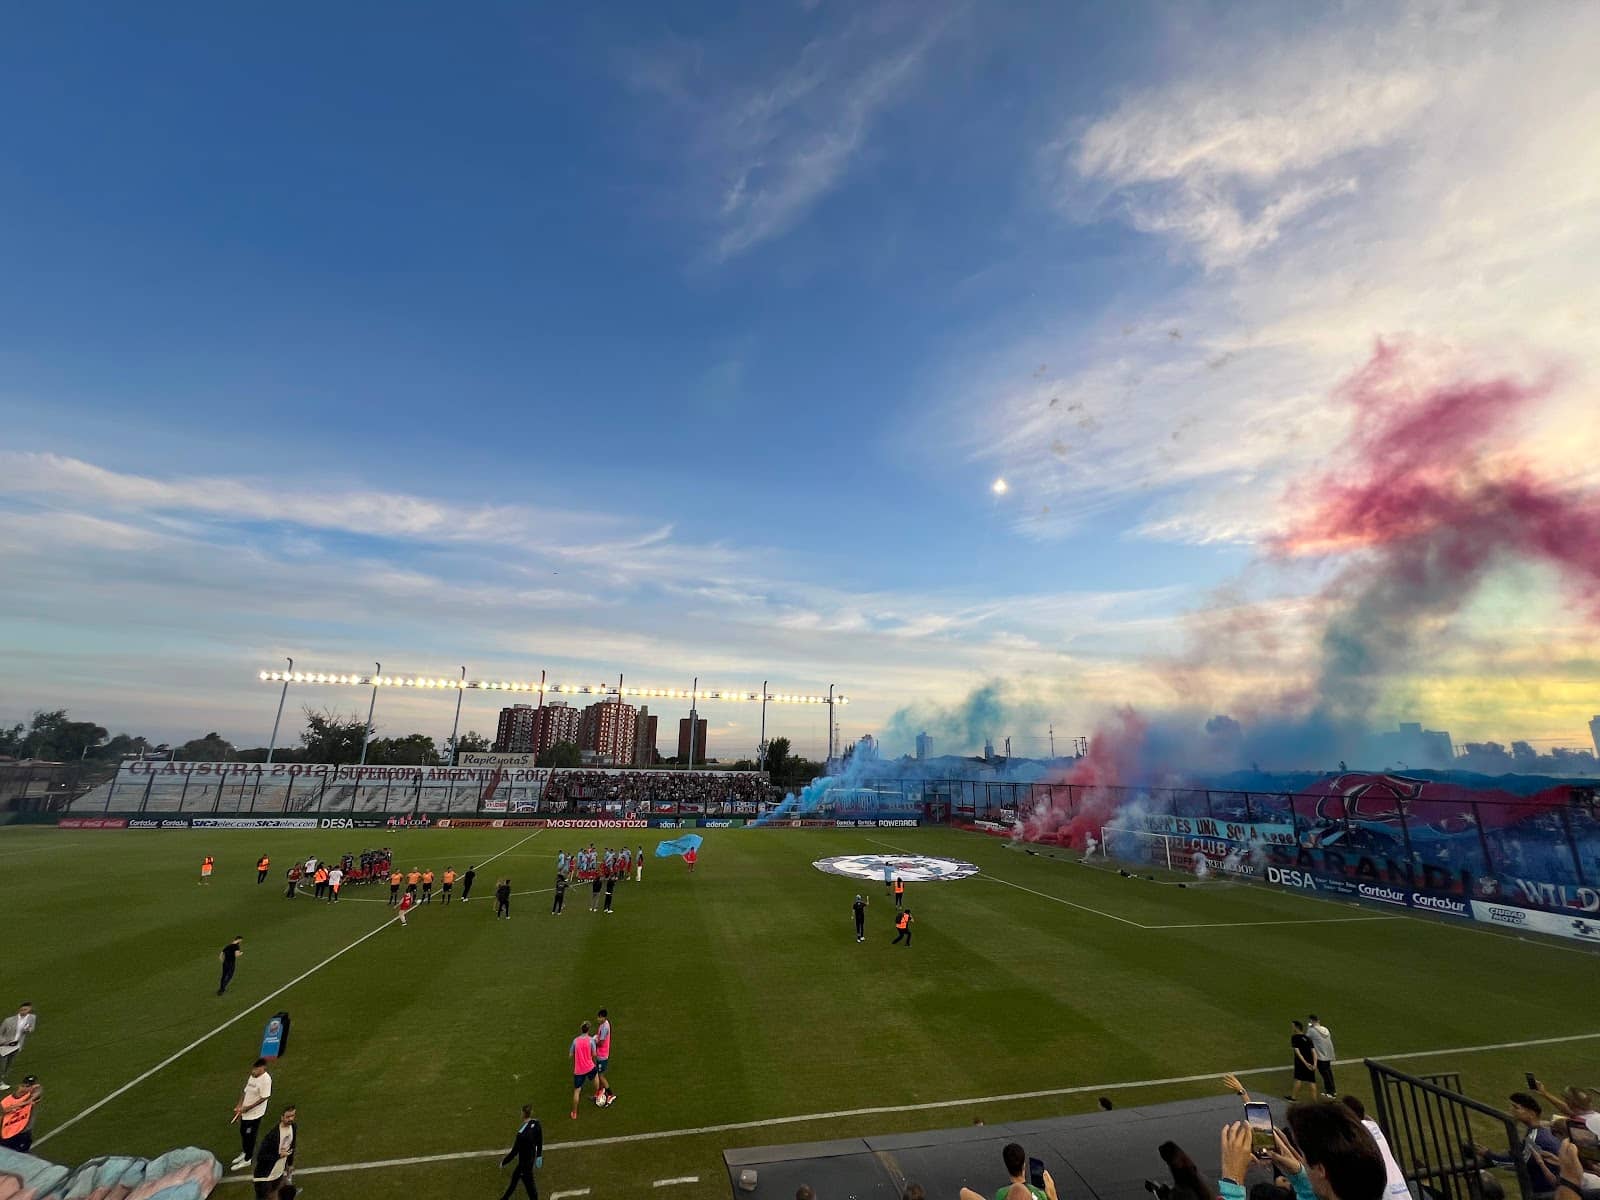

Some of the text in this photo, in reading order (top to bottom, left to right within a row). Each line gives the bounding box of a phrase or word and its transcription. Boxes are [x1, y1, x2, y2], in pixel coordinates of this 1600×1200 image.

[129, 761, 328, 777] CLAUSURA 2012
[339, 766, 423, 780] SUPERCOPA
[427, 768, 510, 782] ARGENTINA
[516, 769, 548, 782] 2012
[320, 818, 354, 829] DESA
[878, 819, 918, 827] POWERADE
[1175, 817, 1191, 833] ES
[1196, 818, 1219, 837] UNA
[1191, 838, 1226, 857] CLUB
[1267, 865, 1317, 890] DESA
[1357, 882, 1404, 902] CartaSur
[1411, 892, 1465, 912] CartaSur
[1489, 907, 1525, 919] CIUDAD
[1492, 914, 1521, 924] MOTO
